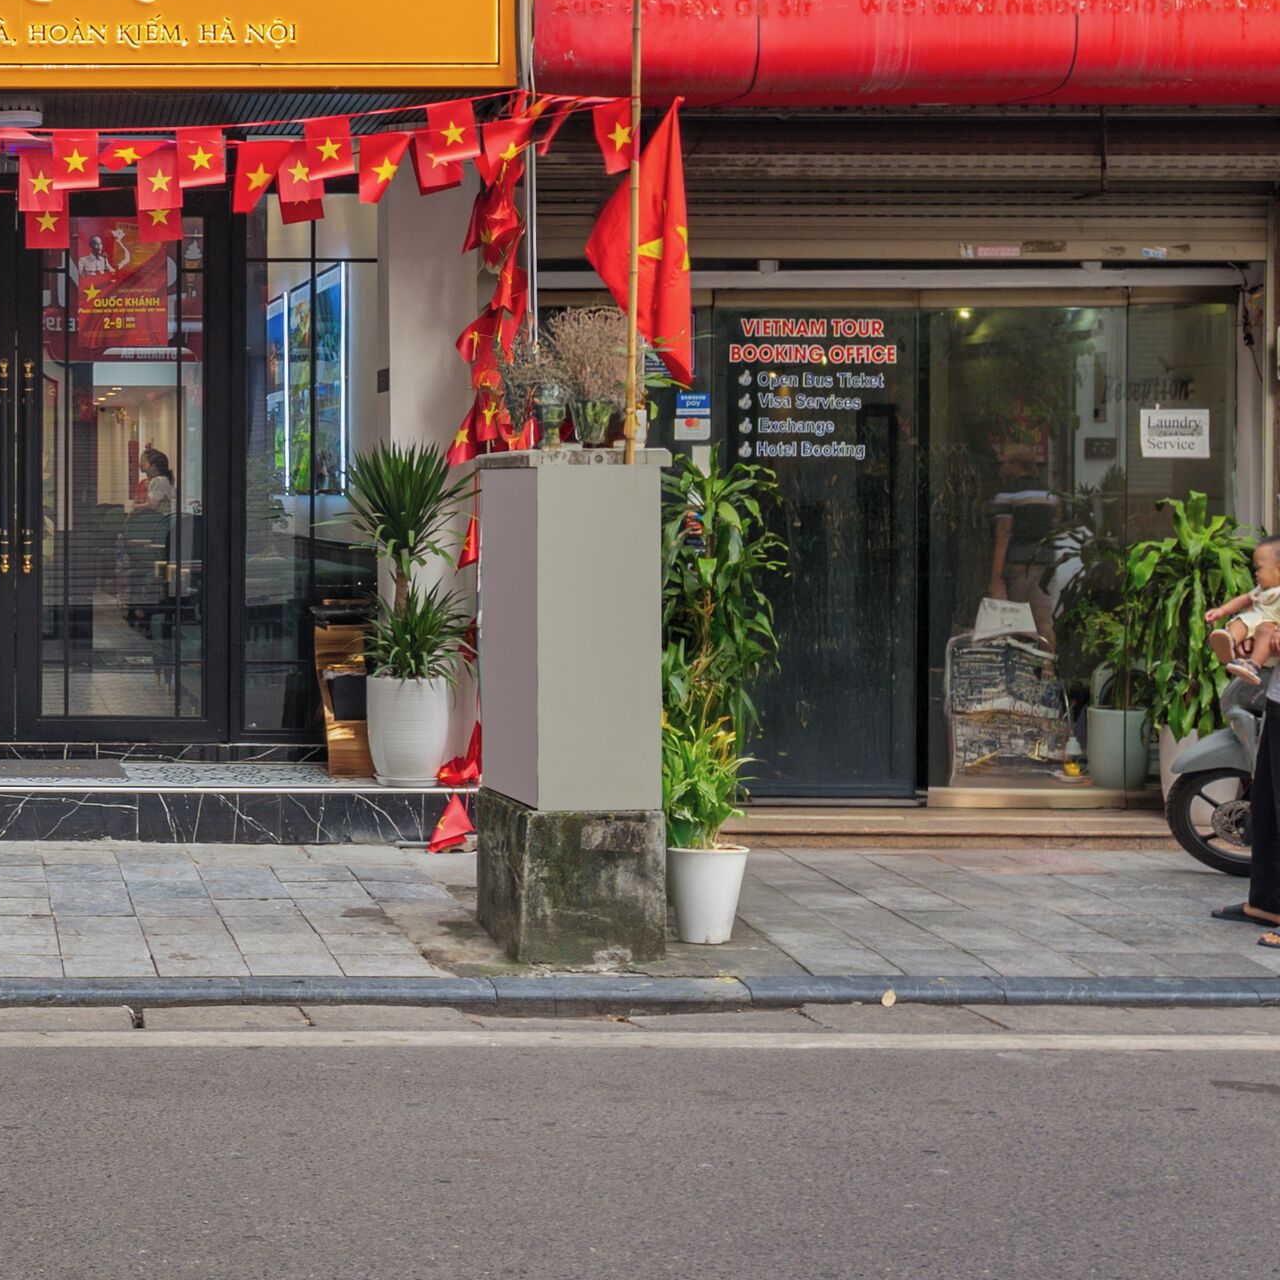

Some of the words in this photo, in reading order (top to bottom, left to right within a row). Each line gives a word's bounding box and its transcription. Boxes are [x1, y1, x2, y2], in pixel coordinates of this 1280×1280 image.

[28, 17, 107, 45] HOÀN
[116, 14, 189, 48] KIẾM,
[198, 17, 237, 44] HÀ
[244, 17, 297, 48] NỘI
[93, 295, 123, 309] QUỐC
[124, 295, 160, 308] KHÁNH
[740, 318, 827, 338] VIETNAM
[831, 318, 885, 338] TOUR
[728, 343, 824, 364] BOOKING
[828, 344, 898, 364] OFFICE
[756, 370, 799, 390] Open
[802, 372, 834, 388] Bus
[836, 371, 885, 389] Ticket
[757, 391, 792, 409] Visa
[794, 392, 862, 410] Services
[757, 417, 835, 437] Exchange
[1147, 416, 1202, 432] Laundry
[756, 440, 797, 458] Hotel
[800, 440, 866, 460] Booking
[1146, 437, 1196, 451] Service
